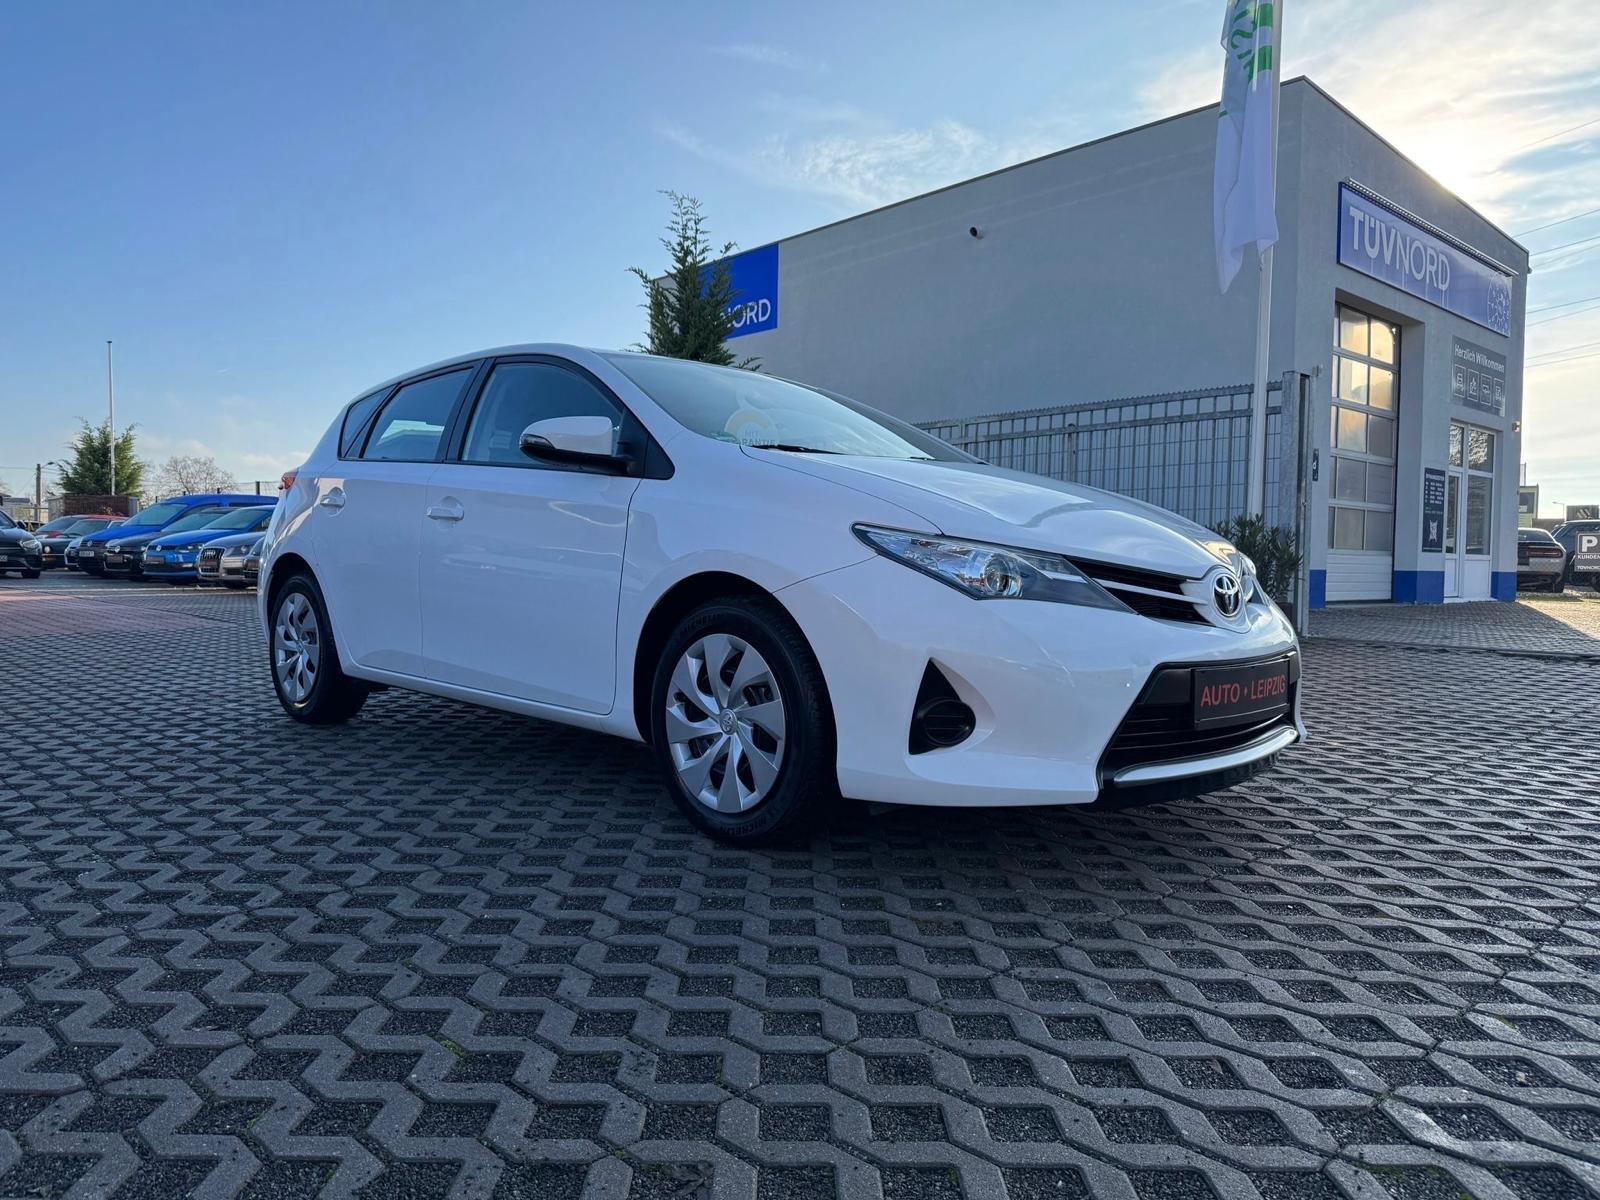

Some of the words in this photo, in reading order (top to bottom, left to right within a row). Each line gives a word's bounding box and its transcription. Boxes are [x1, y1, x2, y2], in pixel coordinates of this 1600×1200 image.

[1454, 344, 1475, 363] Herzlich
[1475, 352, 1504, 373] Willkommen
[1581, 535, 1598, 553] P
[1201, 683, 1240, 706] AUTO
[1251, 674, 1286, 700] LEIPZIG
